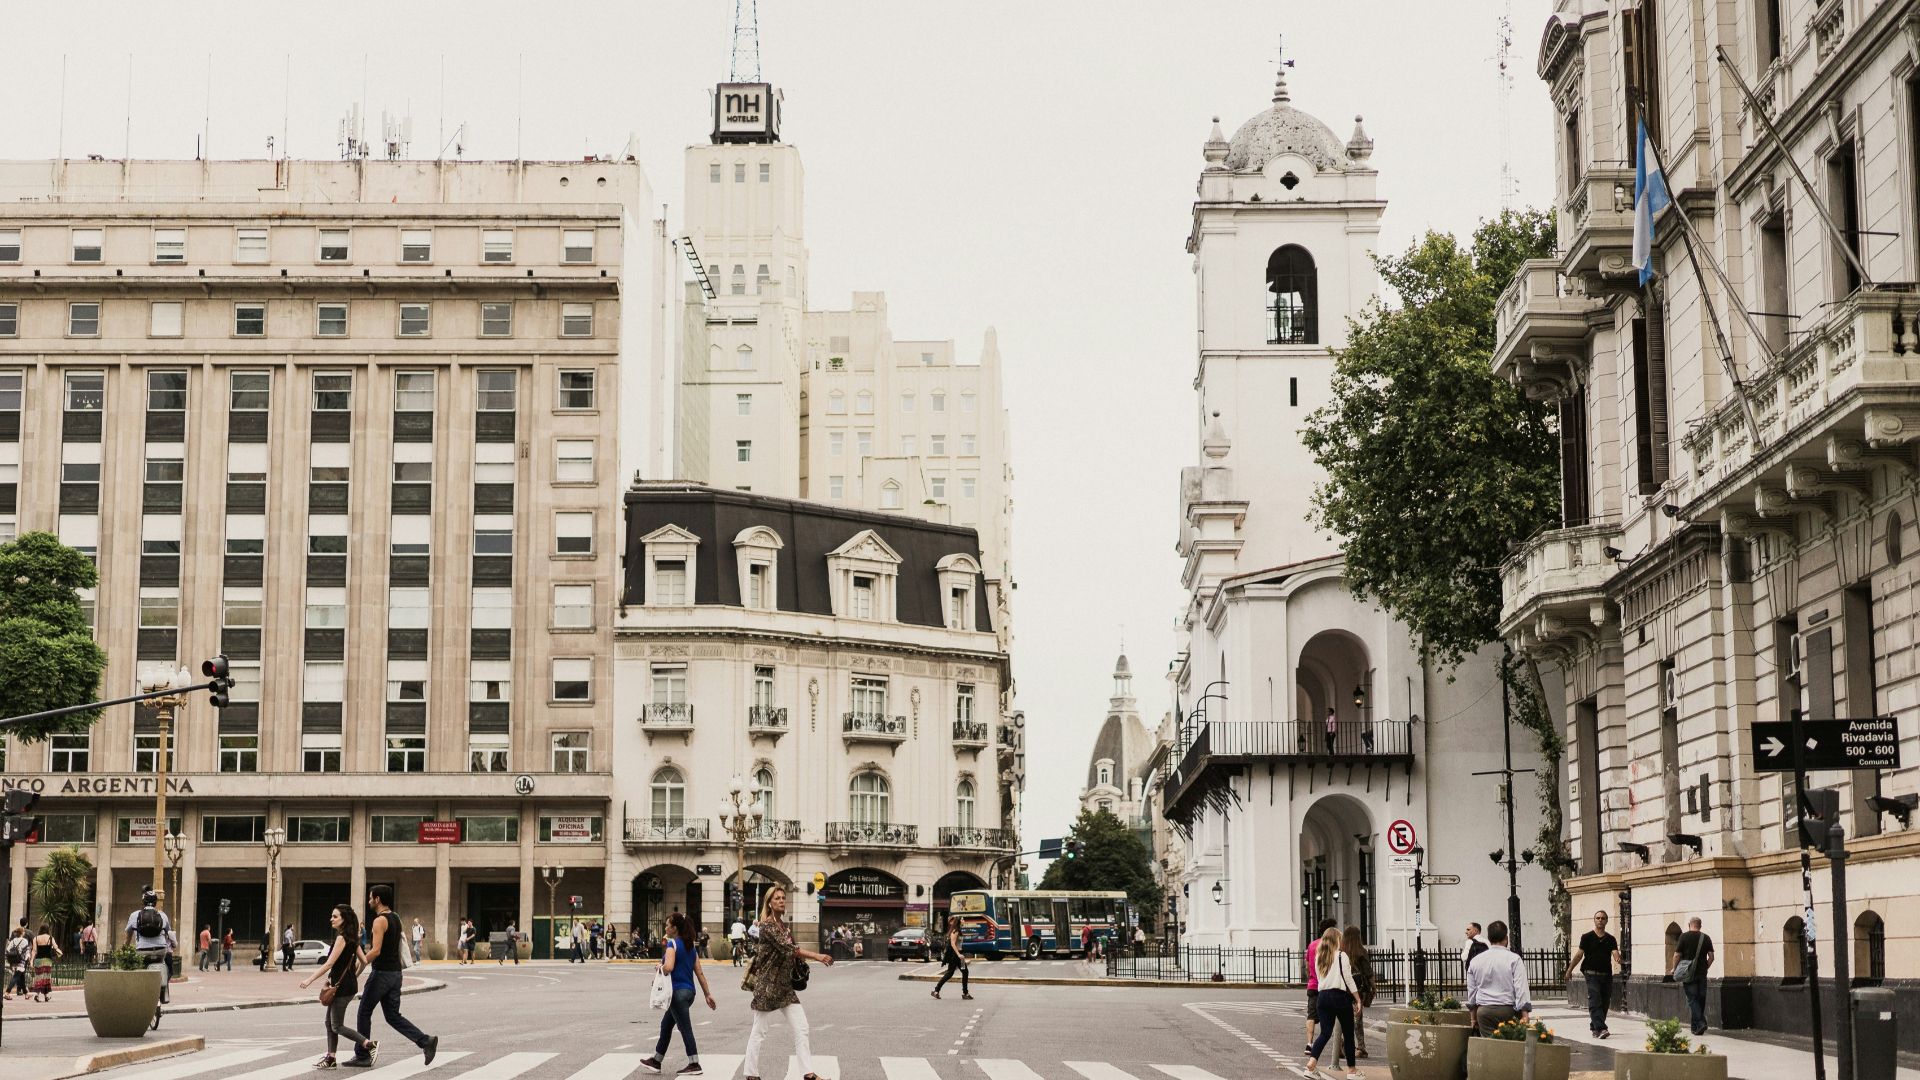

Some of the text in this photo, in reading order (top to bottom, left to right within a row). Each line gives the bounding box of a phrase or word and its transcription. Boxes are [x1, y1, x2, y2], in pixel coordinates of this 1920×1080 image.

[726, 115, 759, 123] HOTELES
[1849, 720, 1893, 730] Avenida
[1841, 731, 1894, 742] Rivadavia
[1014, 713, 1025, 789] CITY
[1846, 745, 1866, 756] 500
[1875, 745, 1895, 755] 600
[1859, 758, 1889, 766] Comuna
[61, 778, 194, 793] ARGENTINA
[1395, 827, 1408, 847] E
[839, 883, 856, 894] GRAN
